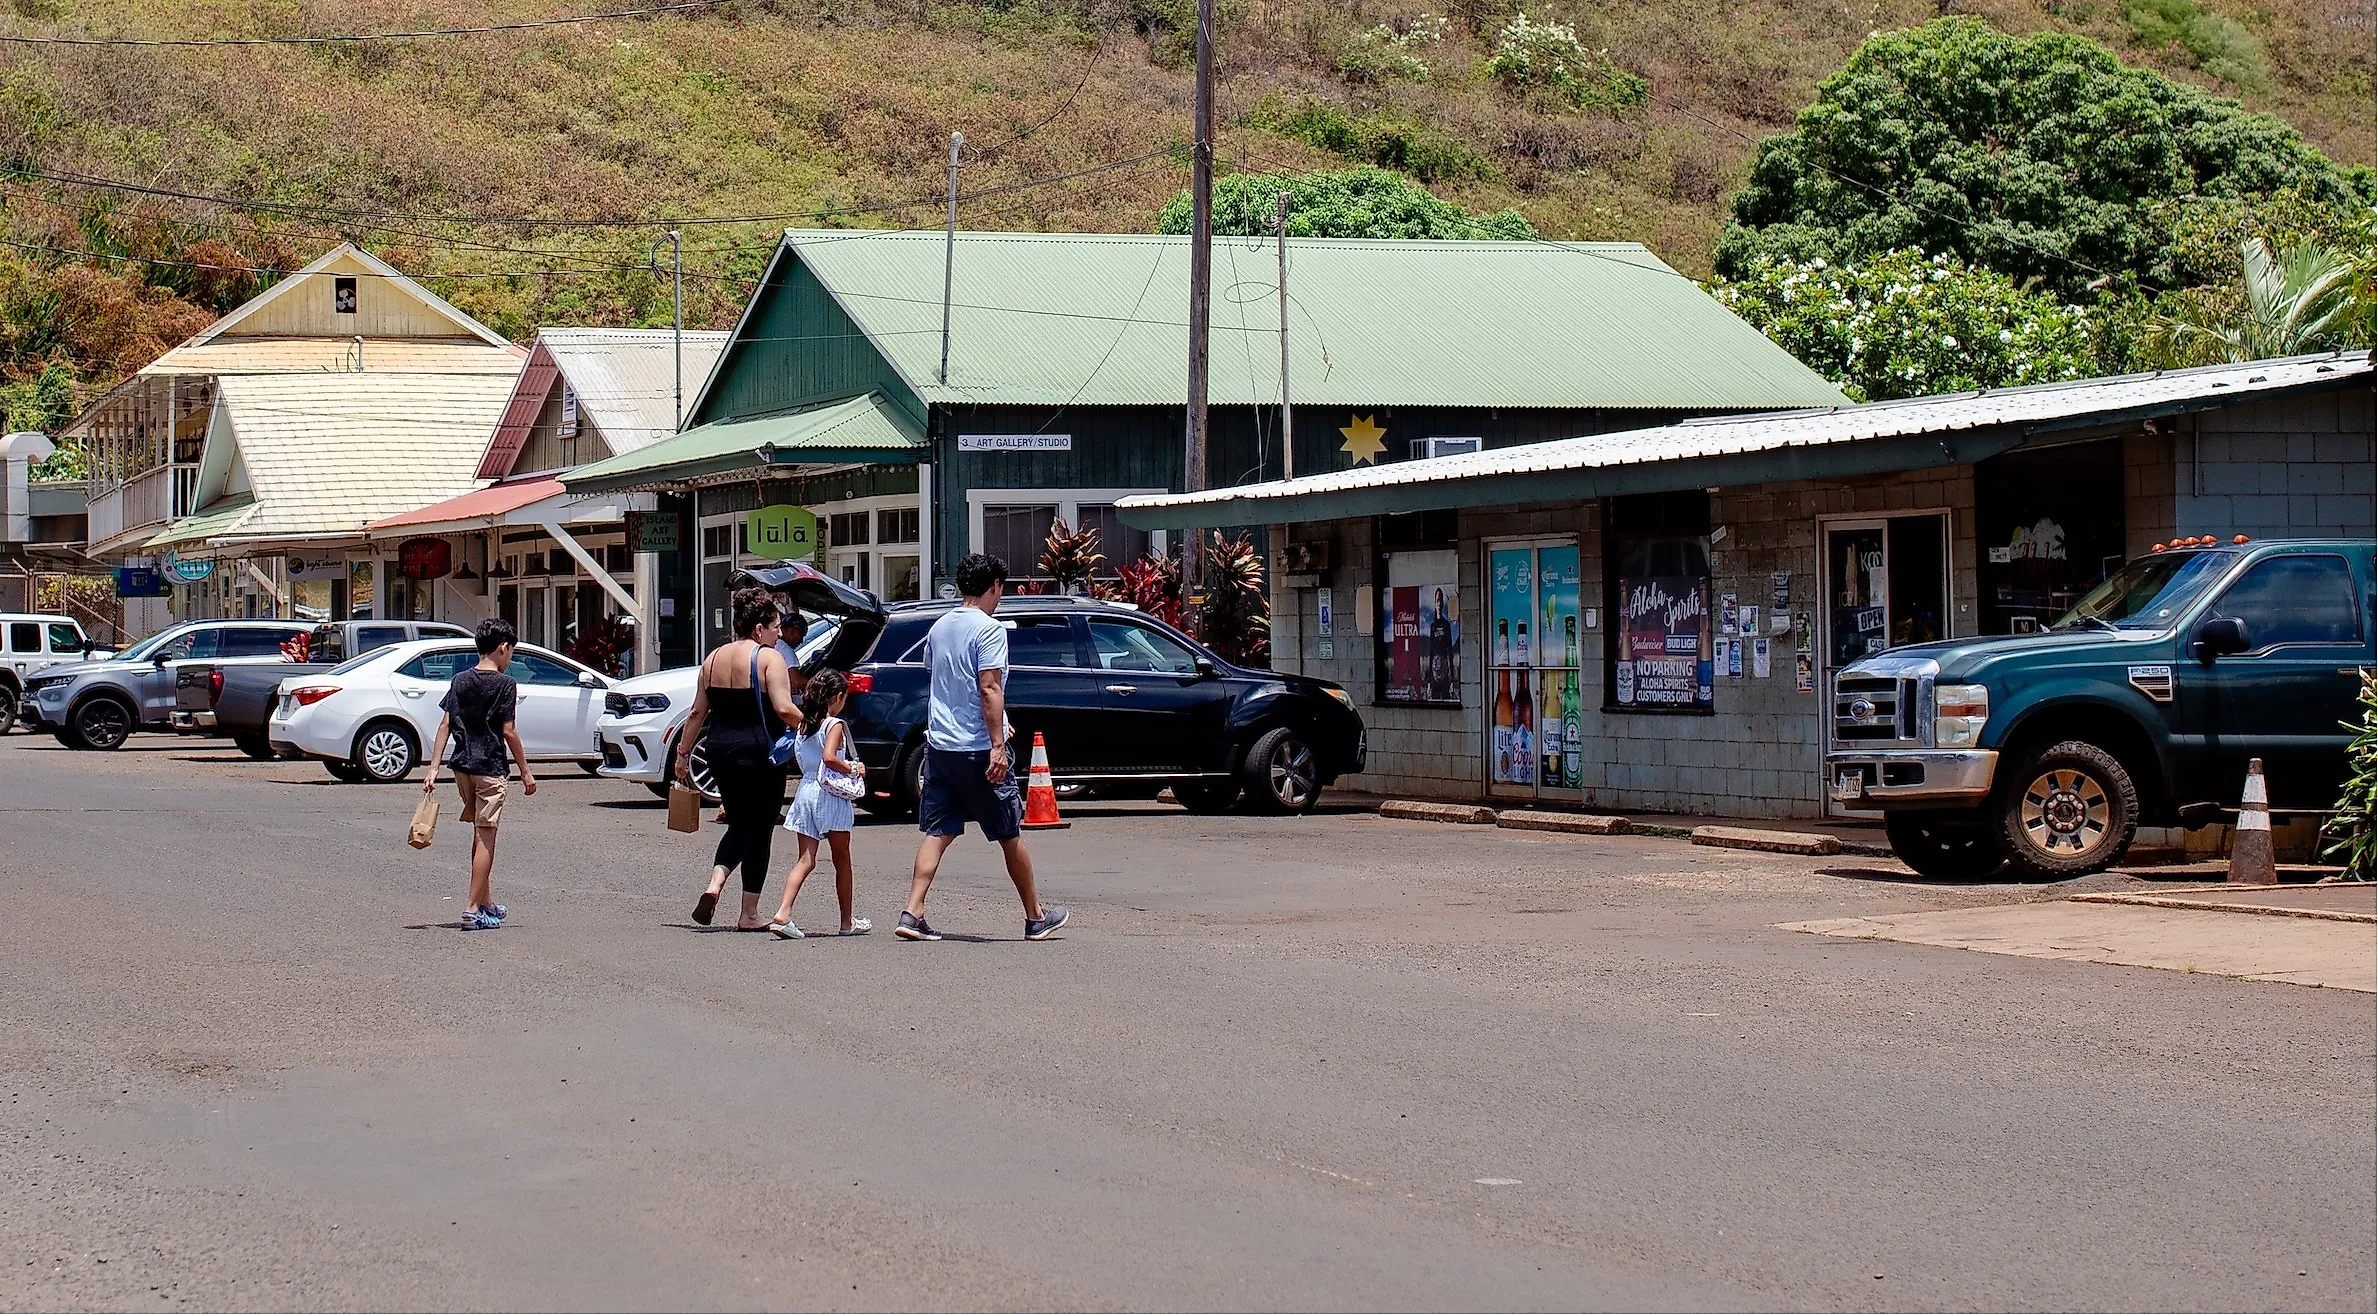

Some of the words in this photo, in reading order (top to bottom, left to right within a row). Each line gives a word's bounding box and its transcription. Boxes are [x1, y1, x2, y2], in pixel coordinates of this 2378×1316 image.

[961, 438, 969, 447] 3
[976, 438, 993, 447] ART
[996, 438, 1069, 448] GALLERY/STUDIO
[645, 515, 677, 524] ISLAND
[652, 526, 669, 535] ART
[642, 537, 677, 546] GALLERY
[1630, 581, 1666, 619] Aloha
[1664, 587, 1701, 635] Spirits
[1860, 609, 1885, 630] OPEN
[1394, 624, 1419, 637] ULTRA
[1631, 636, 1664, 651] Budweiser
[1667, 638, 1680, 649] BUD
[1637, 661, 1651, 676] NO
[1653, 660, 1693, 677] PARKING
[1641, 678, 1663, 690] ALOHA
[1664, 679, 1689, 691] SPIRITS
[1636, 690, 1675, 702] CUSTOMERS
[1676, 691, 1694, 703] ONLY
[1497, 730, 1512, 751] Lite
